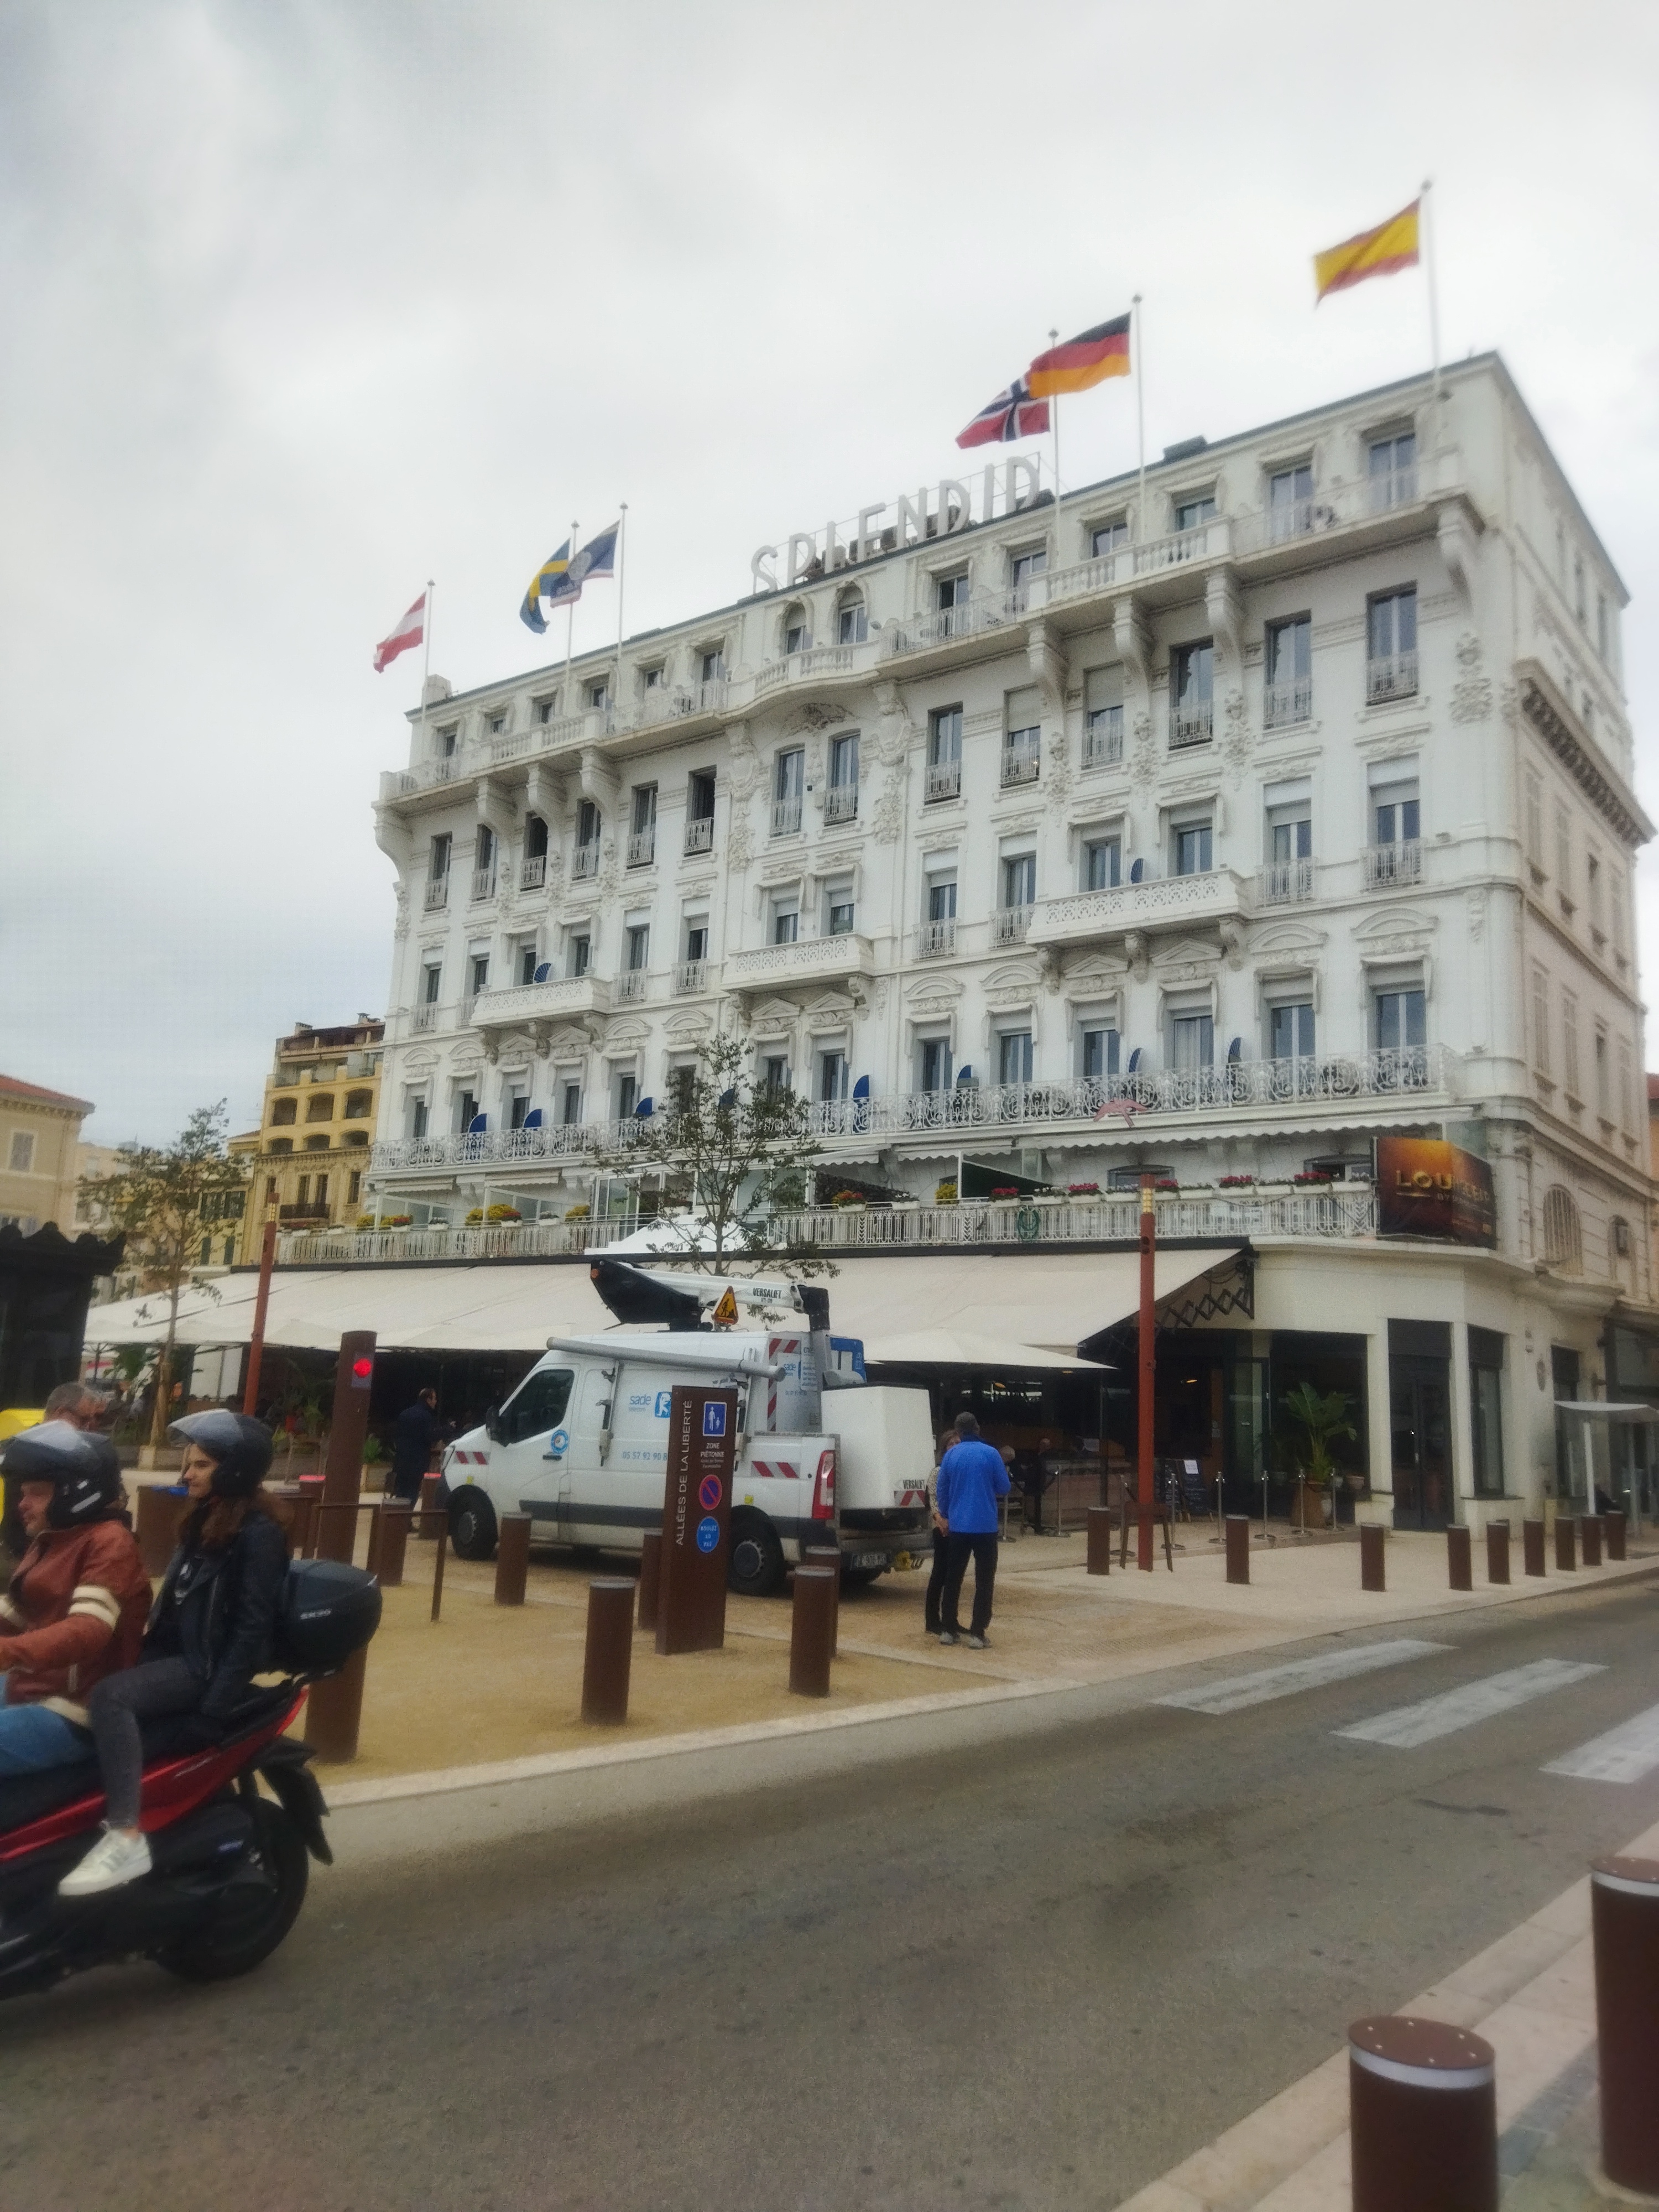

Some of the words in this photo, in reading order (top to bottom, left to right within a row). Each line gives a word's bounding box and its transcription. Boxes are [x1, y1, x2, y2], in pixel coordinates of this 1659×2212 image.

[750, 456, 1040, 593] SPLENDID
[753, 1287, 782, 1299] VERSALIFT
[630, 1395, 651, 1405] sade
[681, 1400, 692, 1453] LIBERTÉ
[643, 1452, 651, 1460] 92
[653, 1452, 661, 1460] 90
[680, 1455, 688, 1472] LA
[679, 1475, 687, 1493] DE
[676, 1496, 686, 1546] ALLÉES
